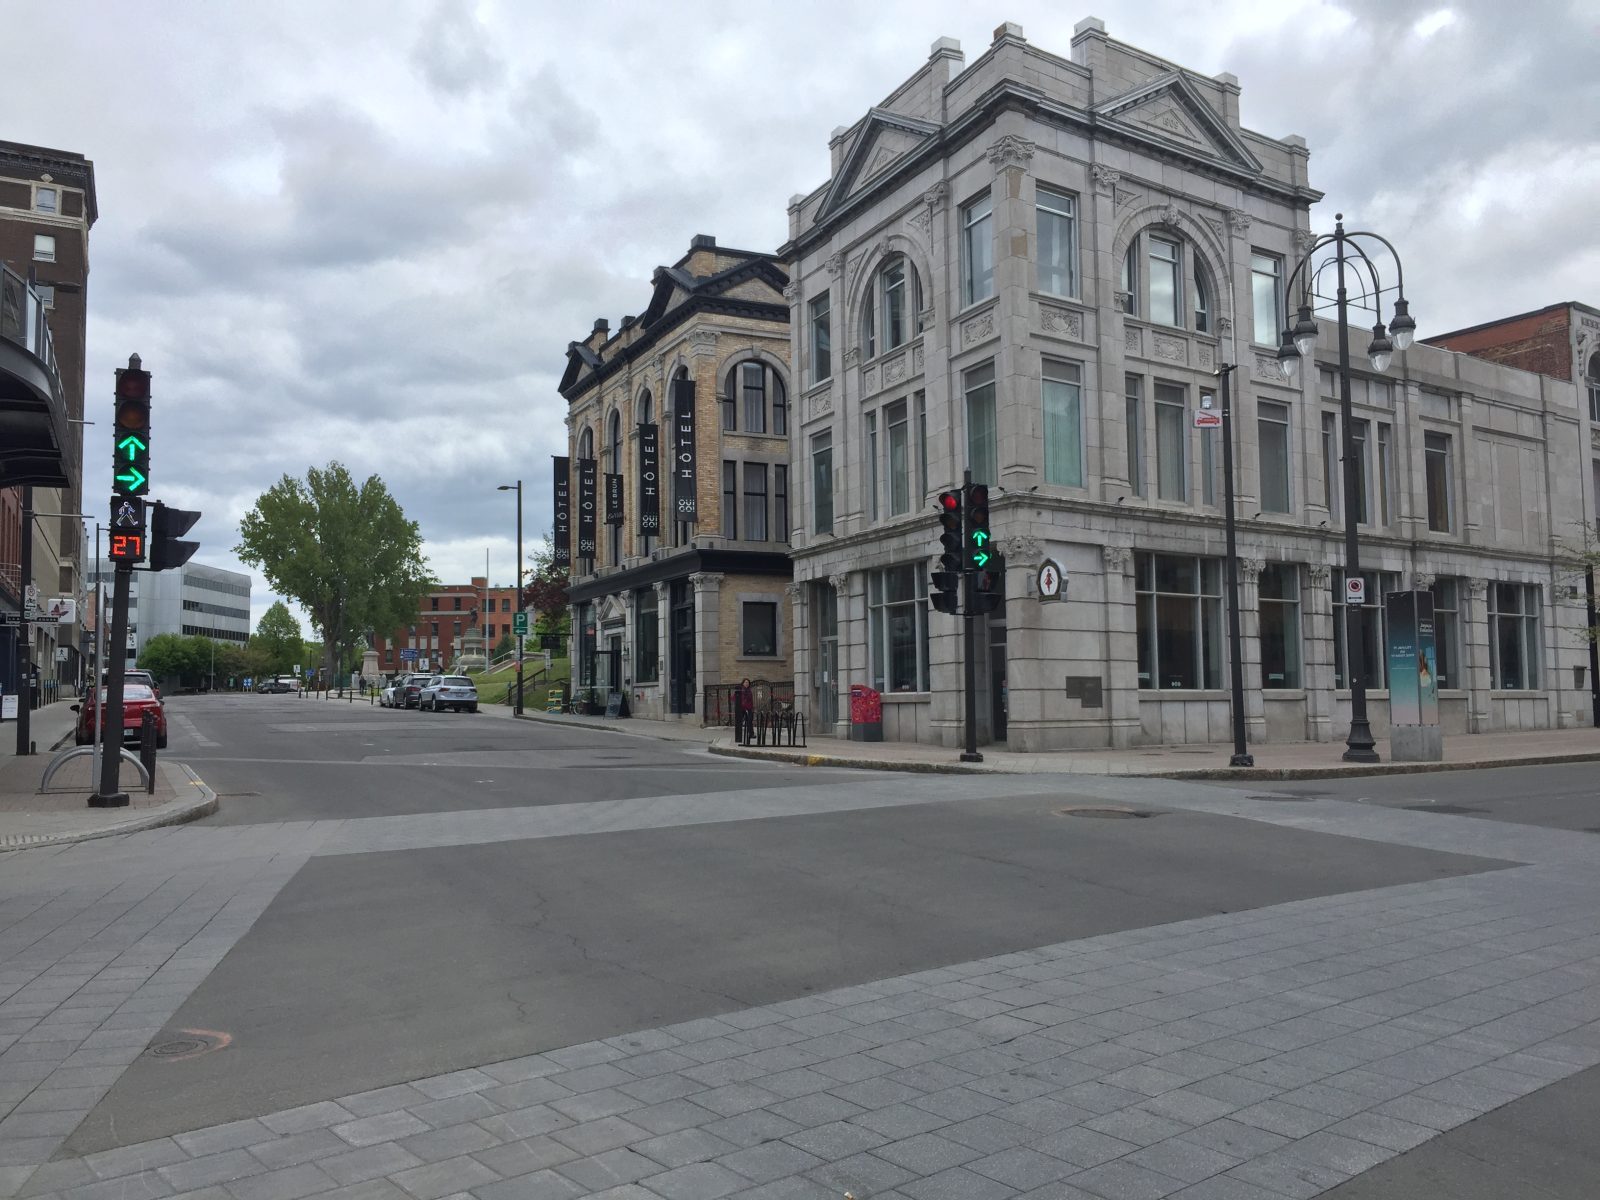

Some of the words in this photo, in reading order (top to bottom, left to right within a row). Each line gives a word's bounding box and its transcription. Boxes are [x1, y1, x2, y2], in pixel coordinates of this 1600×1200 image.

[643, 433, 655, 495] HÔTEL
[679, 412, 692, 478] HÔTEL
[556, 480, 567, 532] HÔTEL
[582, 467, 594, 523] HÔTEL
[612, 500, 618, 509] LE
[113, 535, 140, 555] 27
[516, 614, 525, 626] P
